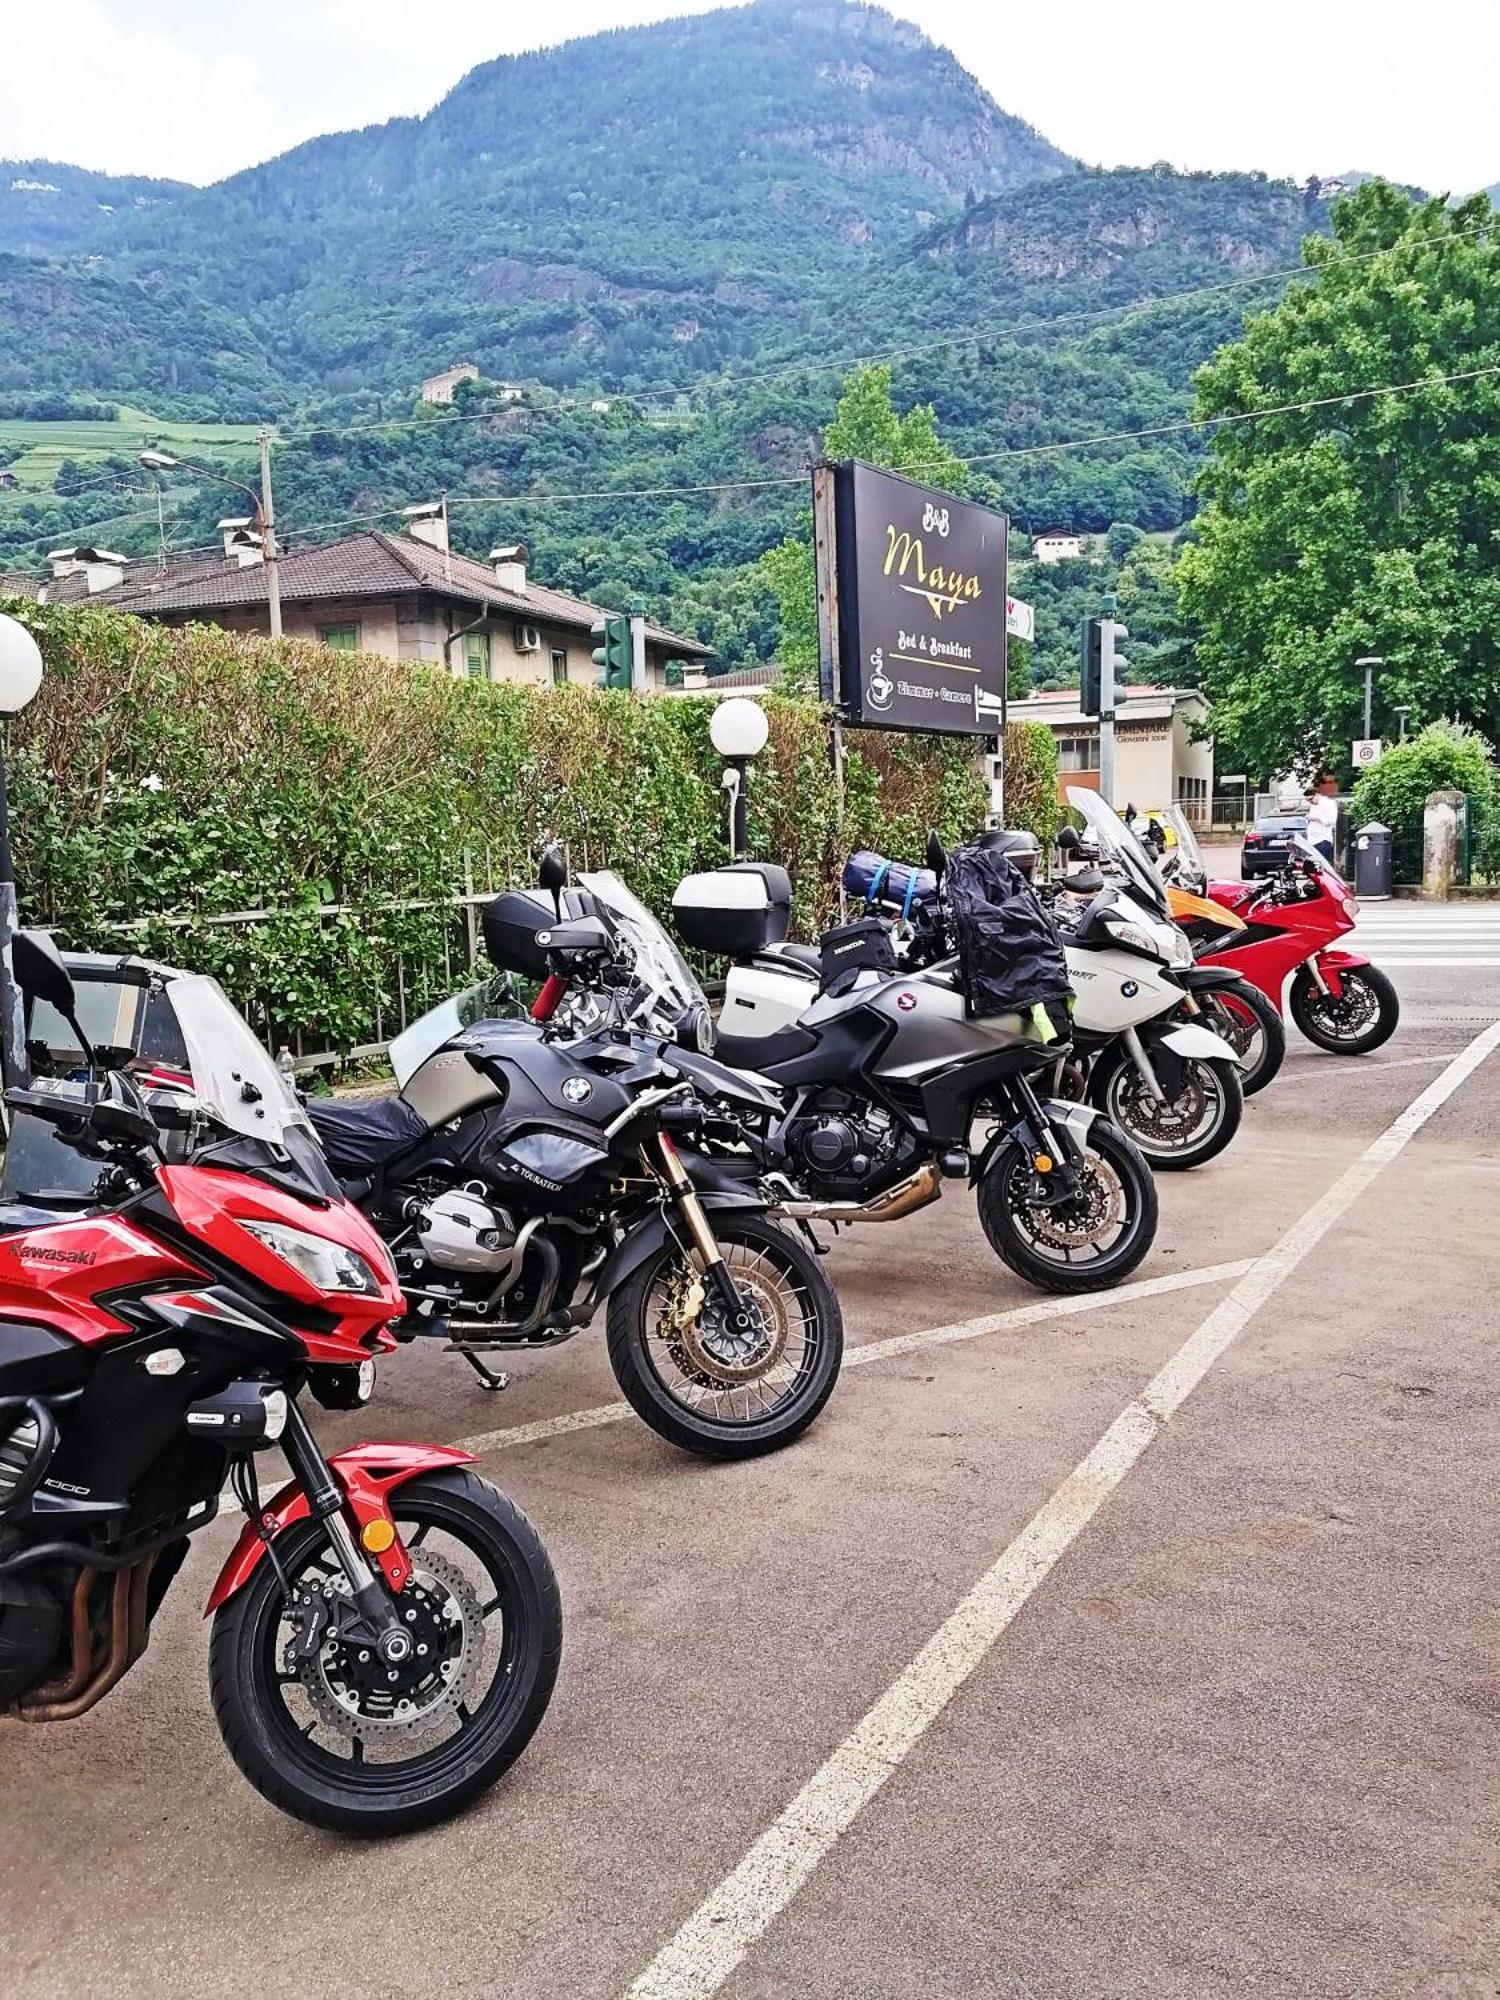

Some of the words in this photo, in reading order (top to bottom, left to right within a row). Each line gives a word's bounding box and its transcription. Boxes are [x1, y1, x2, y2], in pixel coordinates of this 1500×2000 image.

[923, 503, 950, 537] B&B
[884, 524, 982, 612] Maya
[898, 630, 917, 650] Bed
[919, 635, 927, 651] &
[930, 637, 972, 659] Breakfast
[897, 681, 933, 699] Zimmer
[940, 687, 972, 704] Camere
[834, 940, 865, 955] HONDA
[521, 1167, 562, 1191] TOURATECH
[9, 1243, 97, 1265] Kawasaki
[44, 1478, 91, 1495] 1000
